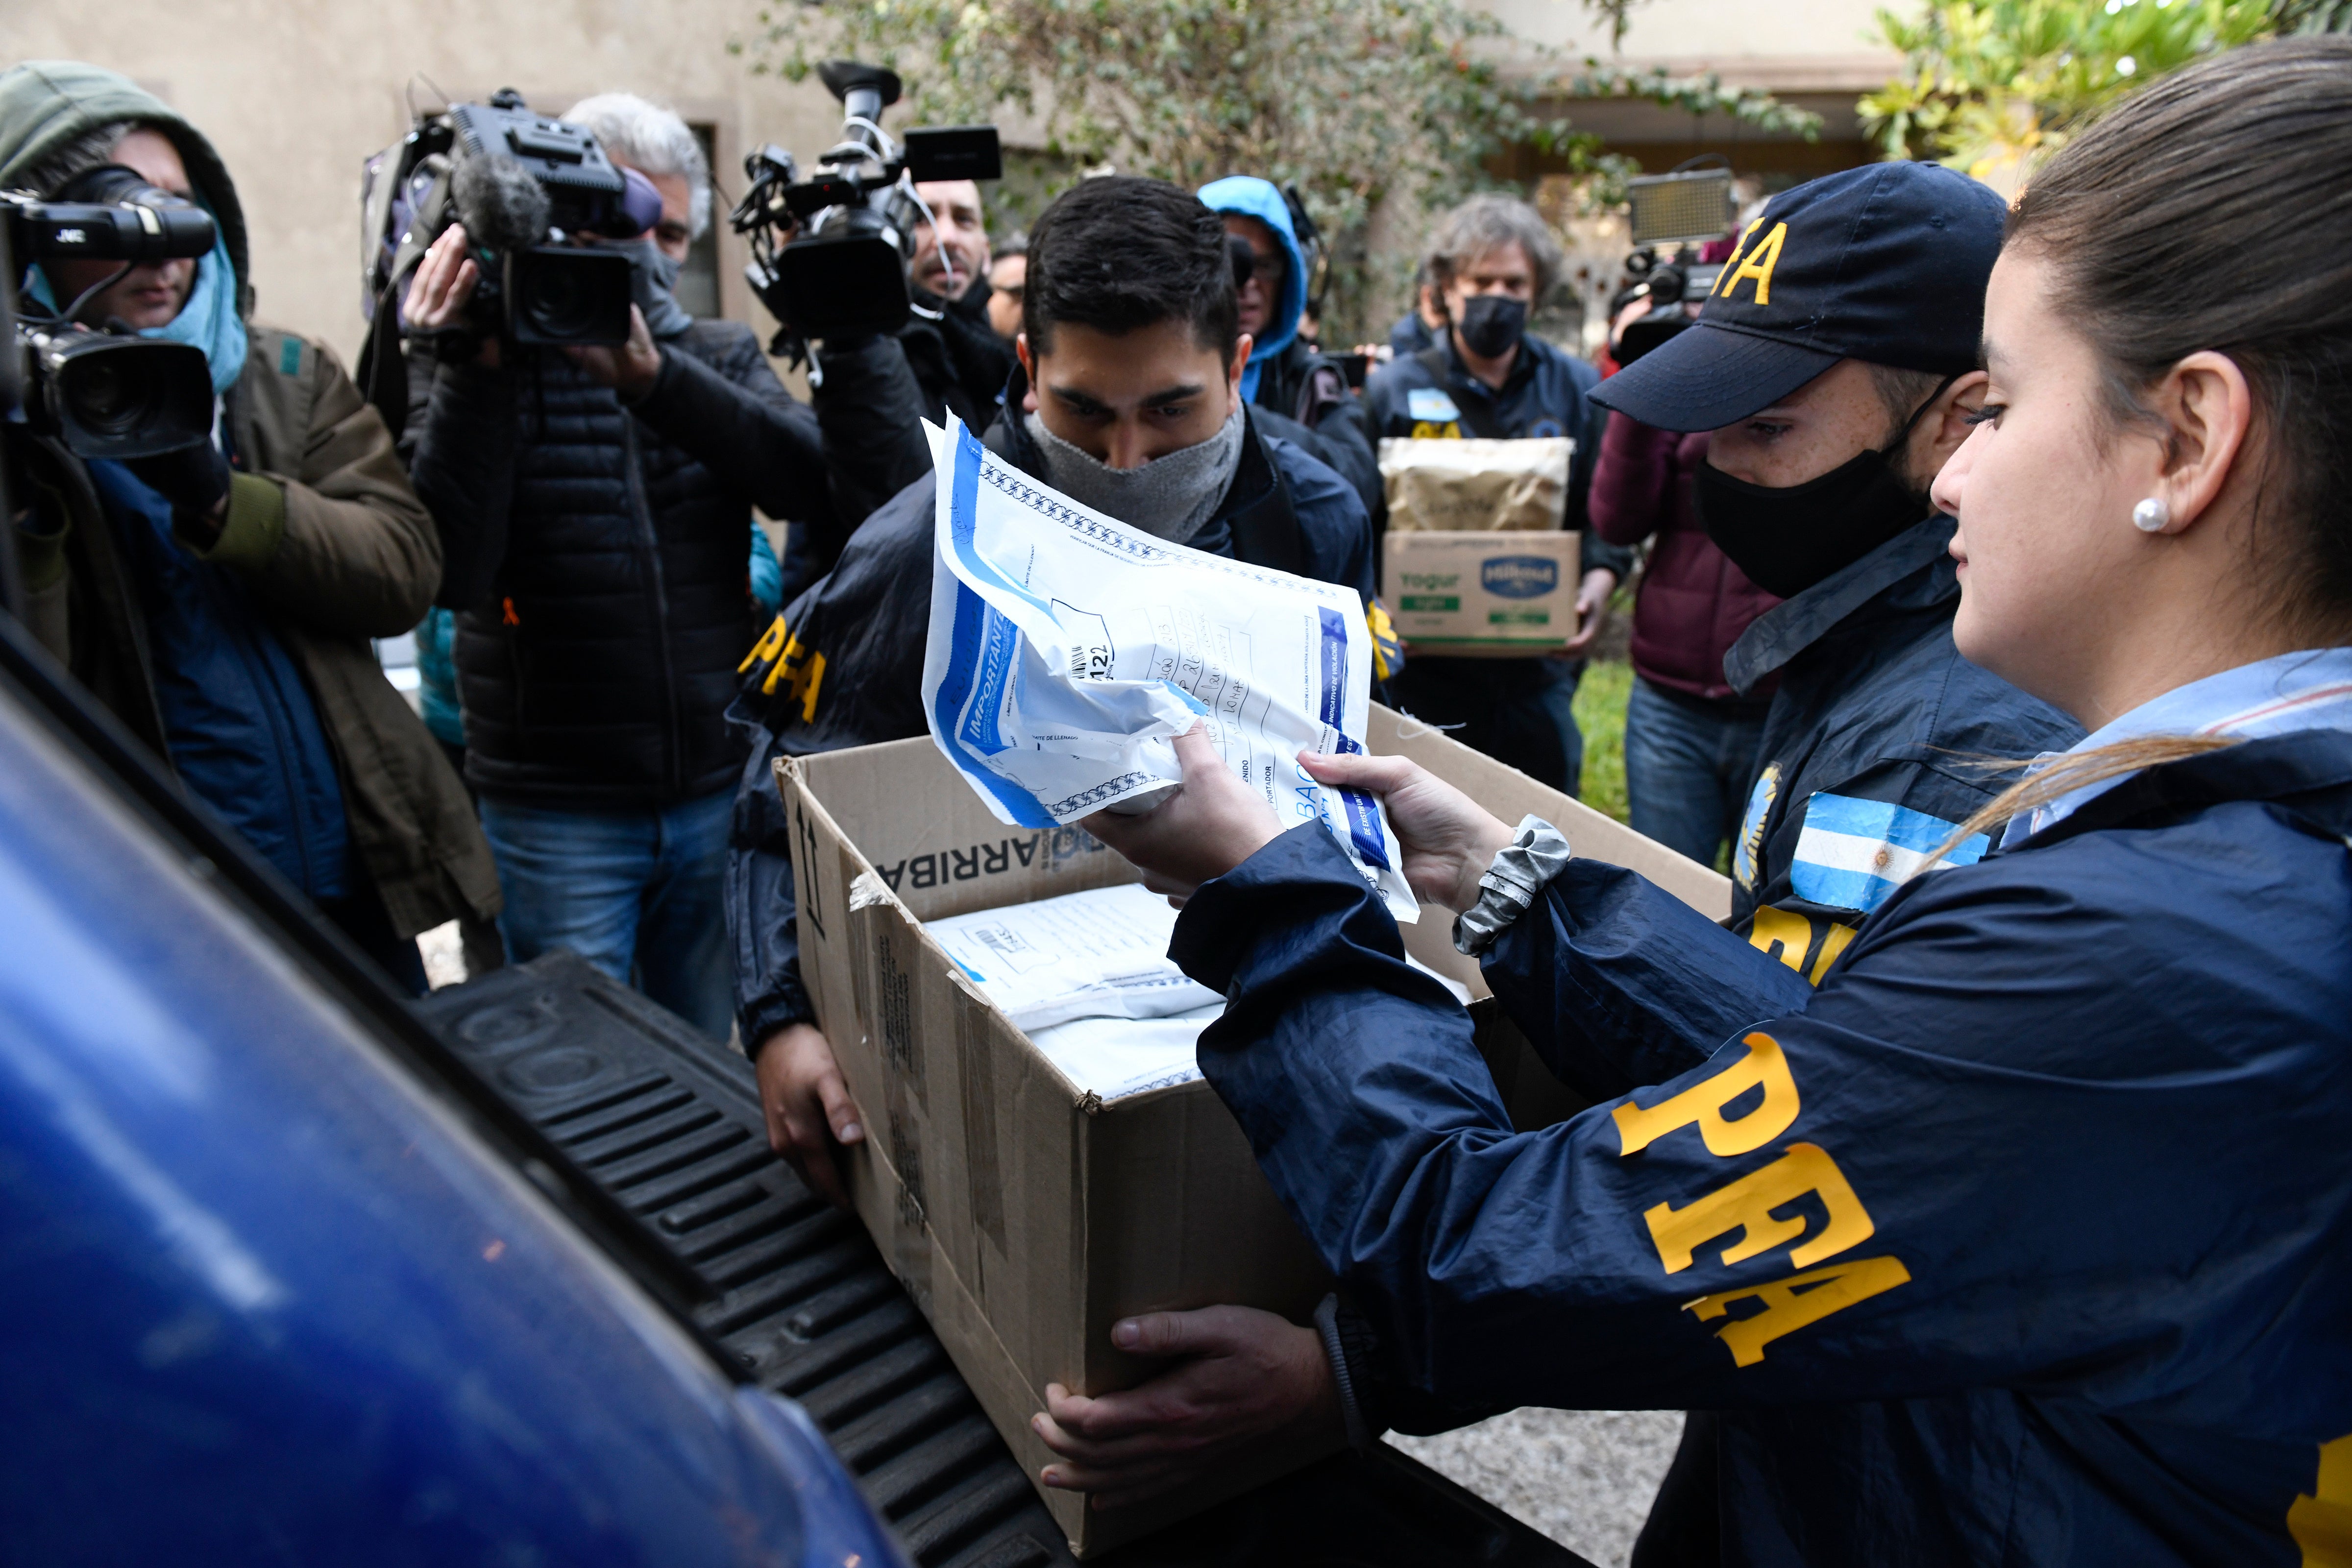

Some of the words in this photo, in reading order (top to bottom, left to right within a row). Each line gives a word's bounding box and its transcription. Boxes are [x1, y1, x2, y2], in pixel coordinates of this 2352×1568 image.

[55, 229, 86, 243] JVC
[1100, 548, 1114, 556] FRANJA
[737, 615, 827, 725] PFA
[1090, 645, 1108, 680] 122
[1331, 675, 1338, 686] DE
[1328, 686, 1337, 724] INDICATIVO
[1265, 766, 1274, 803] PORTADOR
[1358, 806, 1369, 827] EXISTIR
[1363, 827, 1372, 836] DE
[876, 833, 1041, 894] ARRIBA
[1612, 1032, 1912, 1368] PFA
